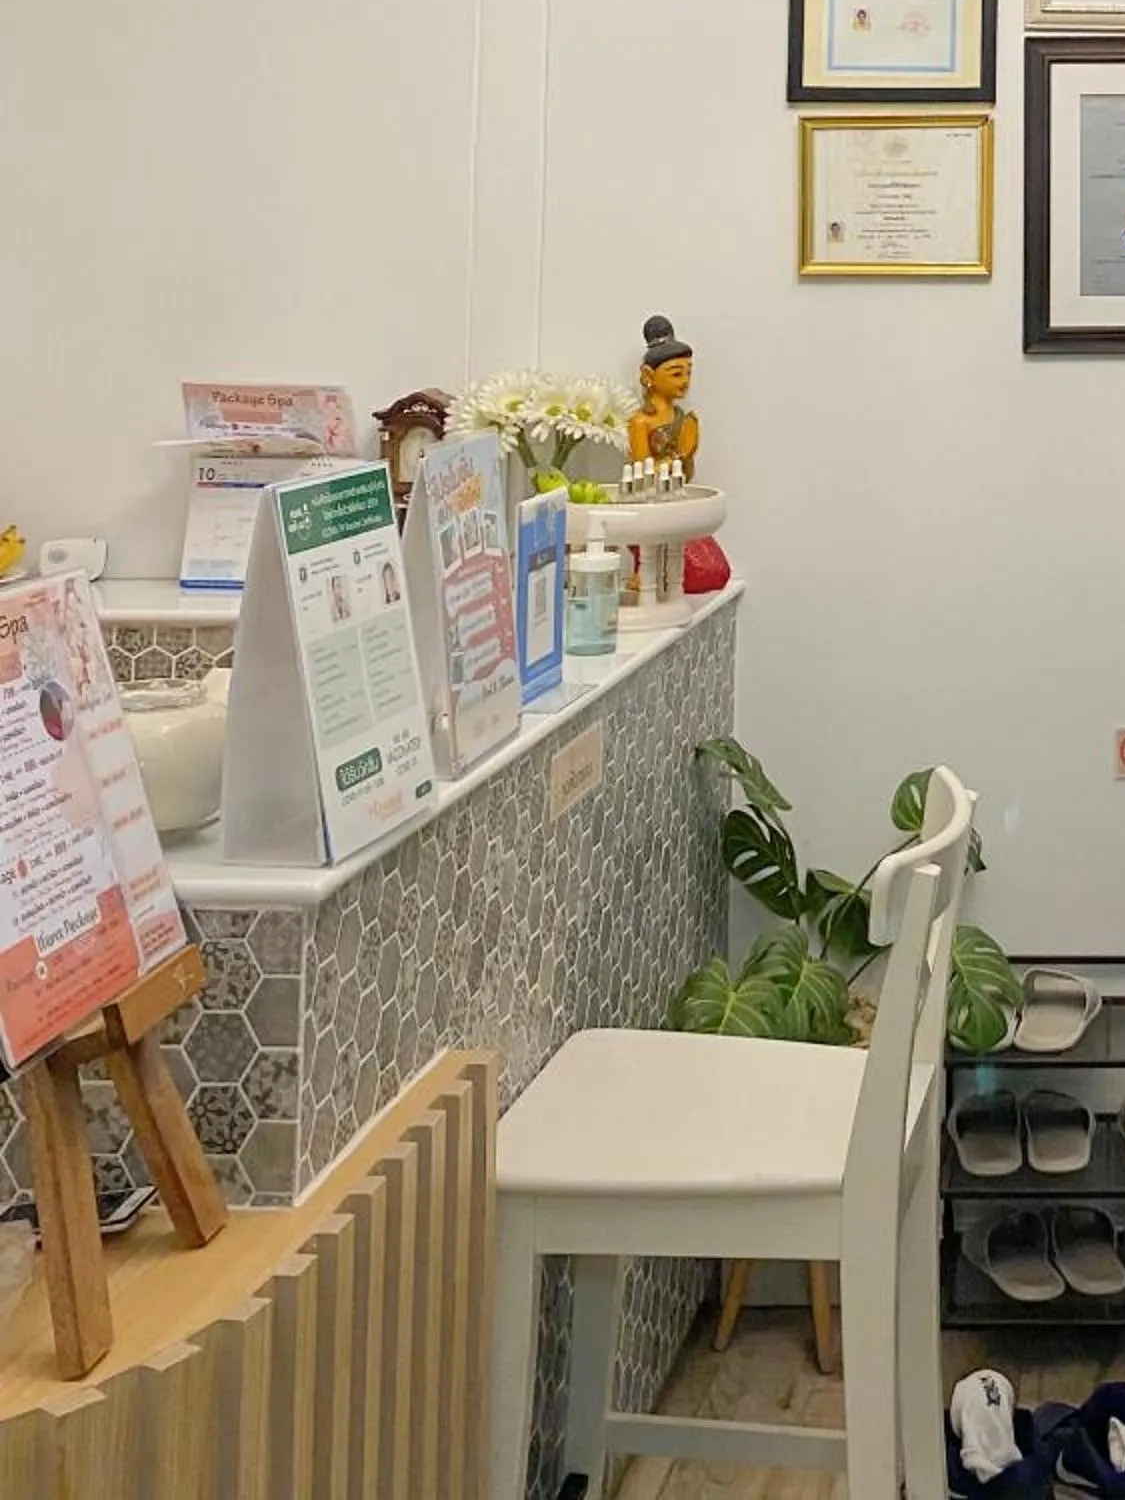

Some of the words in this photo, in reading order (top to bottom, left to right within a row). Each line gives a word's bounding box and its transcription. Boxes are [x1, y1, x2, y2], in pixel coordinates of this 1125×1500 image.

[210, 390, 265, 409] Package
[268, 393, 294, 408] Spa
[198, 467, 216, 482] 10
[0, 614, 30, 645] Spa
